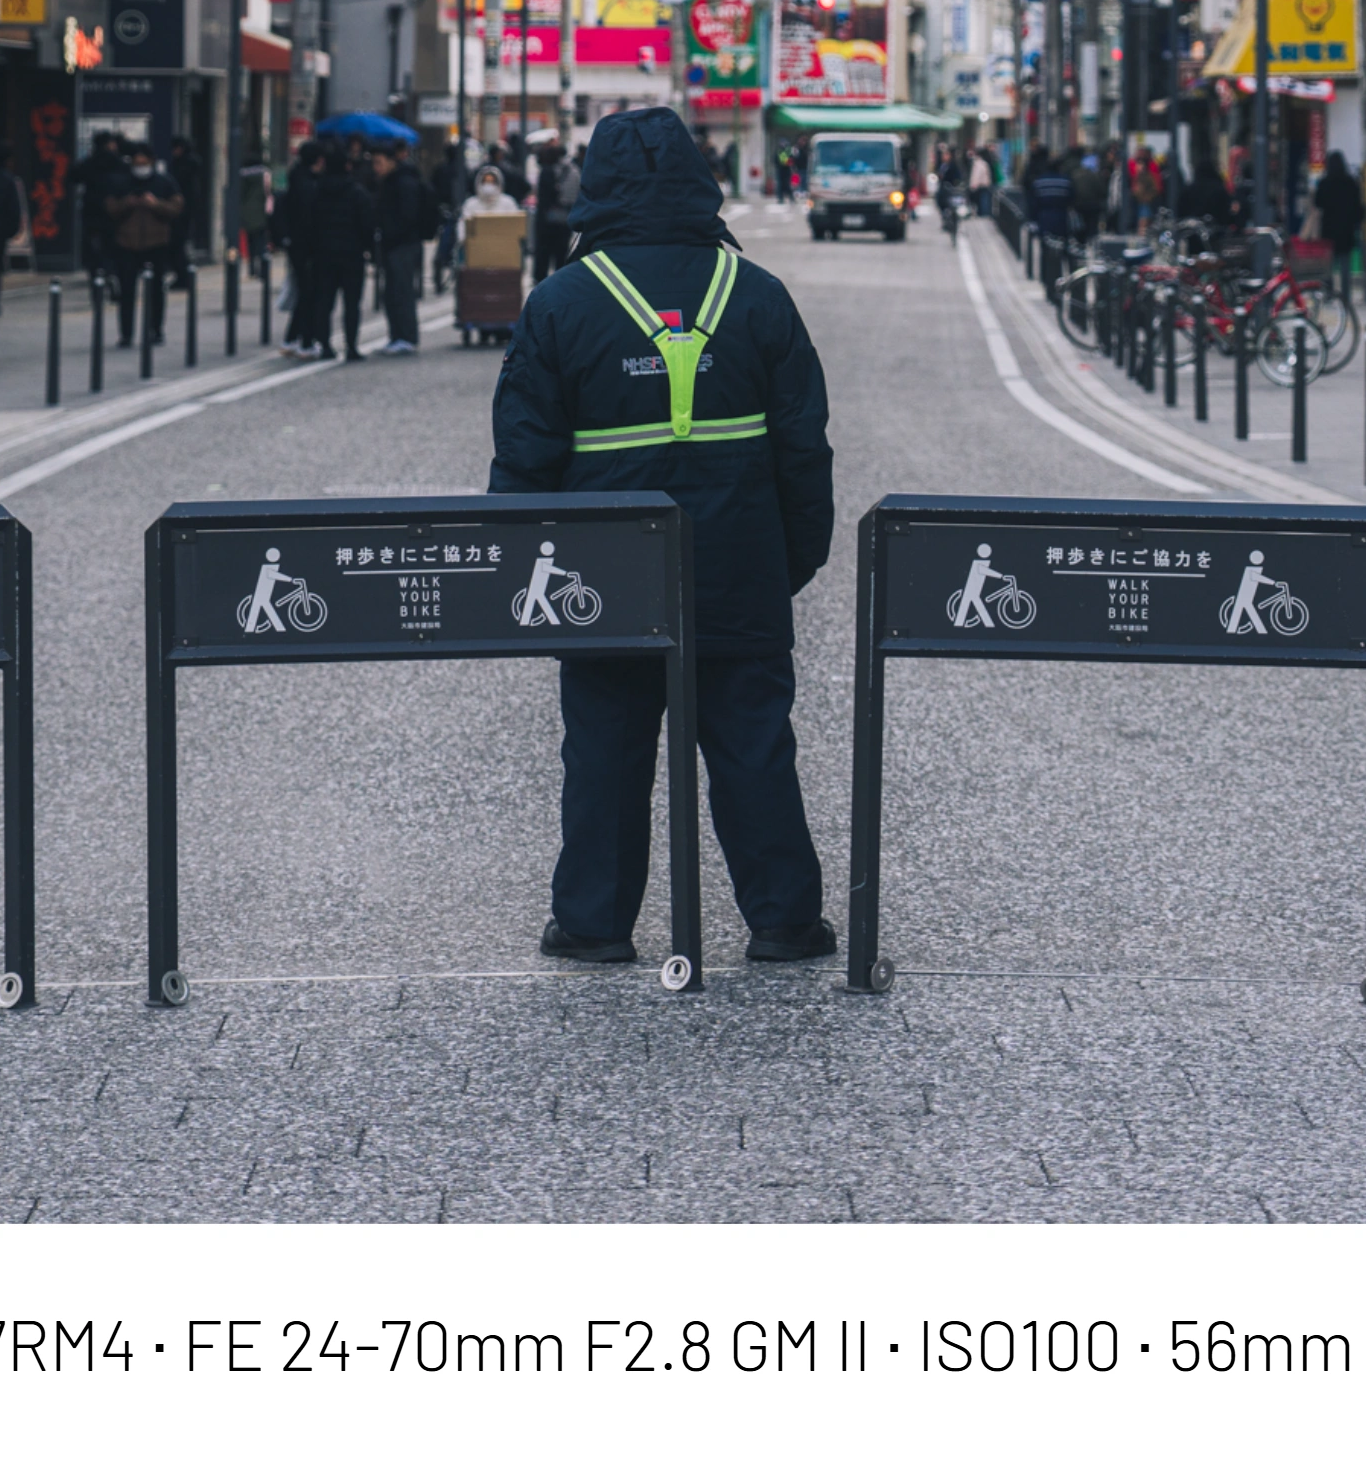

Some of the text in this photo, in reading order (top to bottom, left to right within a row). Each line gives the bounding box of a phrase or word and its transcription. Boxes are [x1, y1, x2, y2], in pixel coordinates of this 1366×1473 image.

[336, 545, 502, 565] 押歩きにご協力を
[1046, 547, 1211, 569] 押歩きにご協力を
[399, 577, 440, 588] WALK
[1108, 580, 1149, 590] WALK
[400, 591, 440, 603] YOUR
[1109, 593, 1149, 605] YOUR
[400, 605, 440, 617] BIKE
[1108, 607, 1148, 620] BIKE
